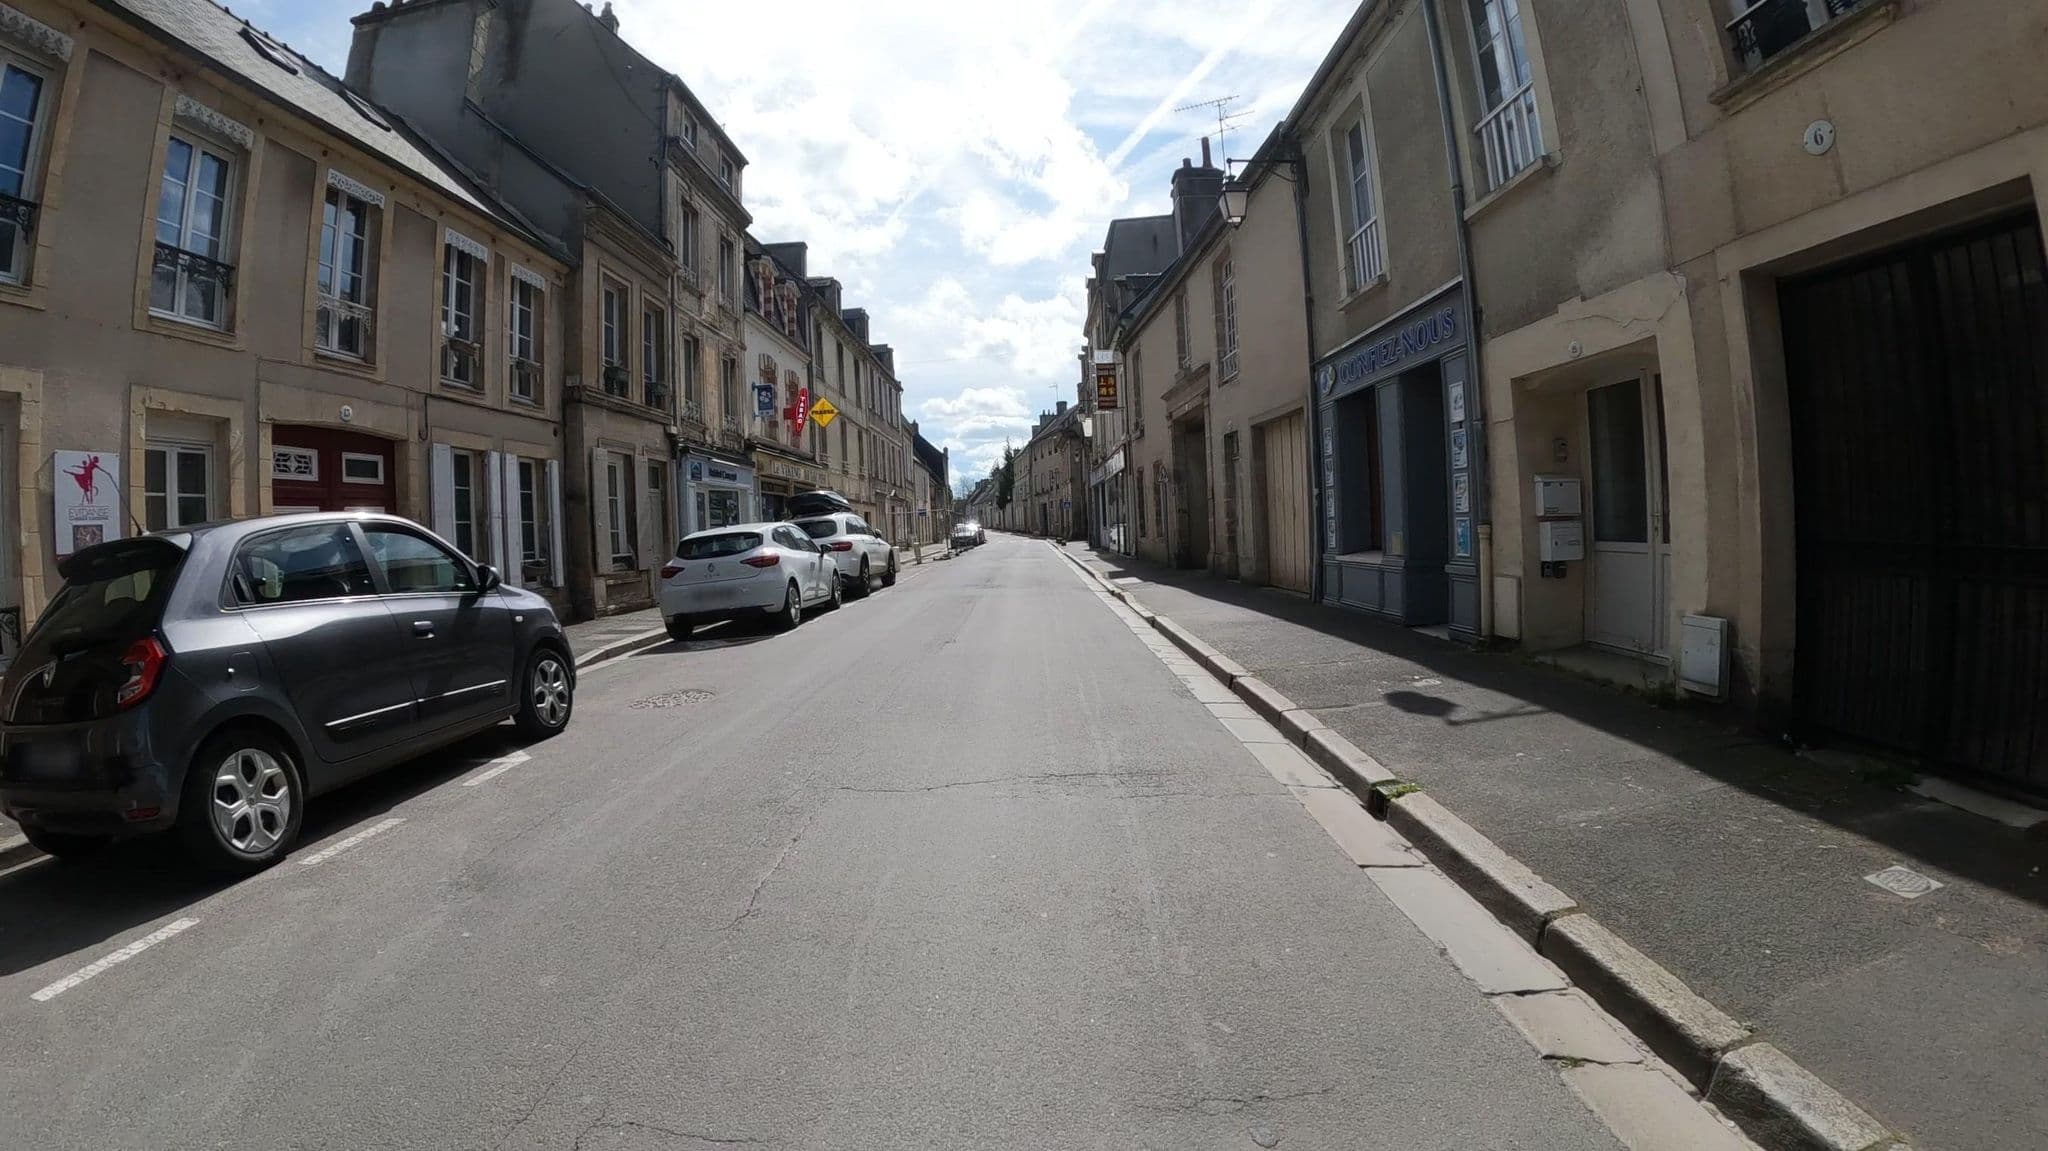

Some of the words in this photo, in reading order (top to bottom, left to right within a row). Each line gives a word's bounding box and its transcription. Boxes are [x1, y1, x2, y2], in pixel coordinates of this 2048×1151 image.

[1814, 127, 1824, 145] 6
[1338, 306, 1455, 385] CONFIEZ-NOUS
[797, 396, 805, 424] TABAC
